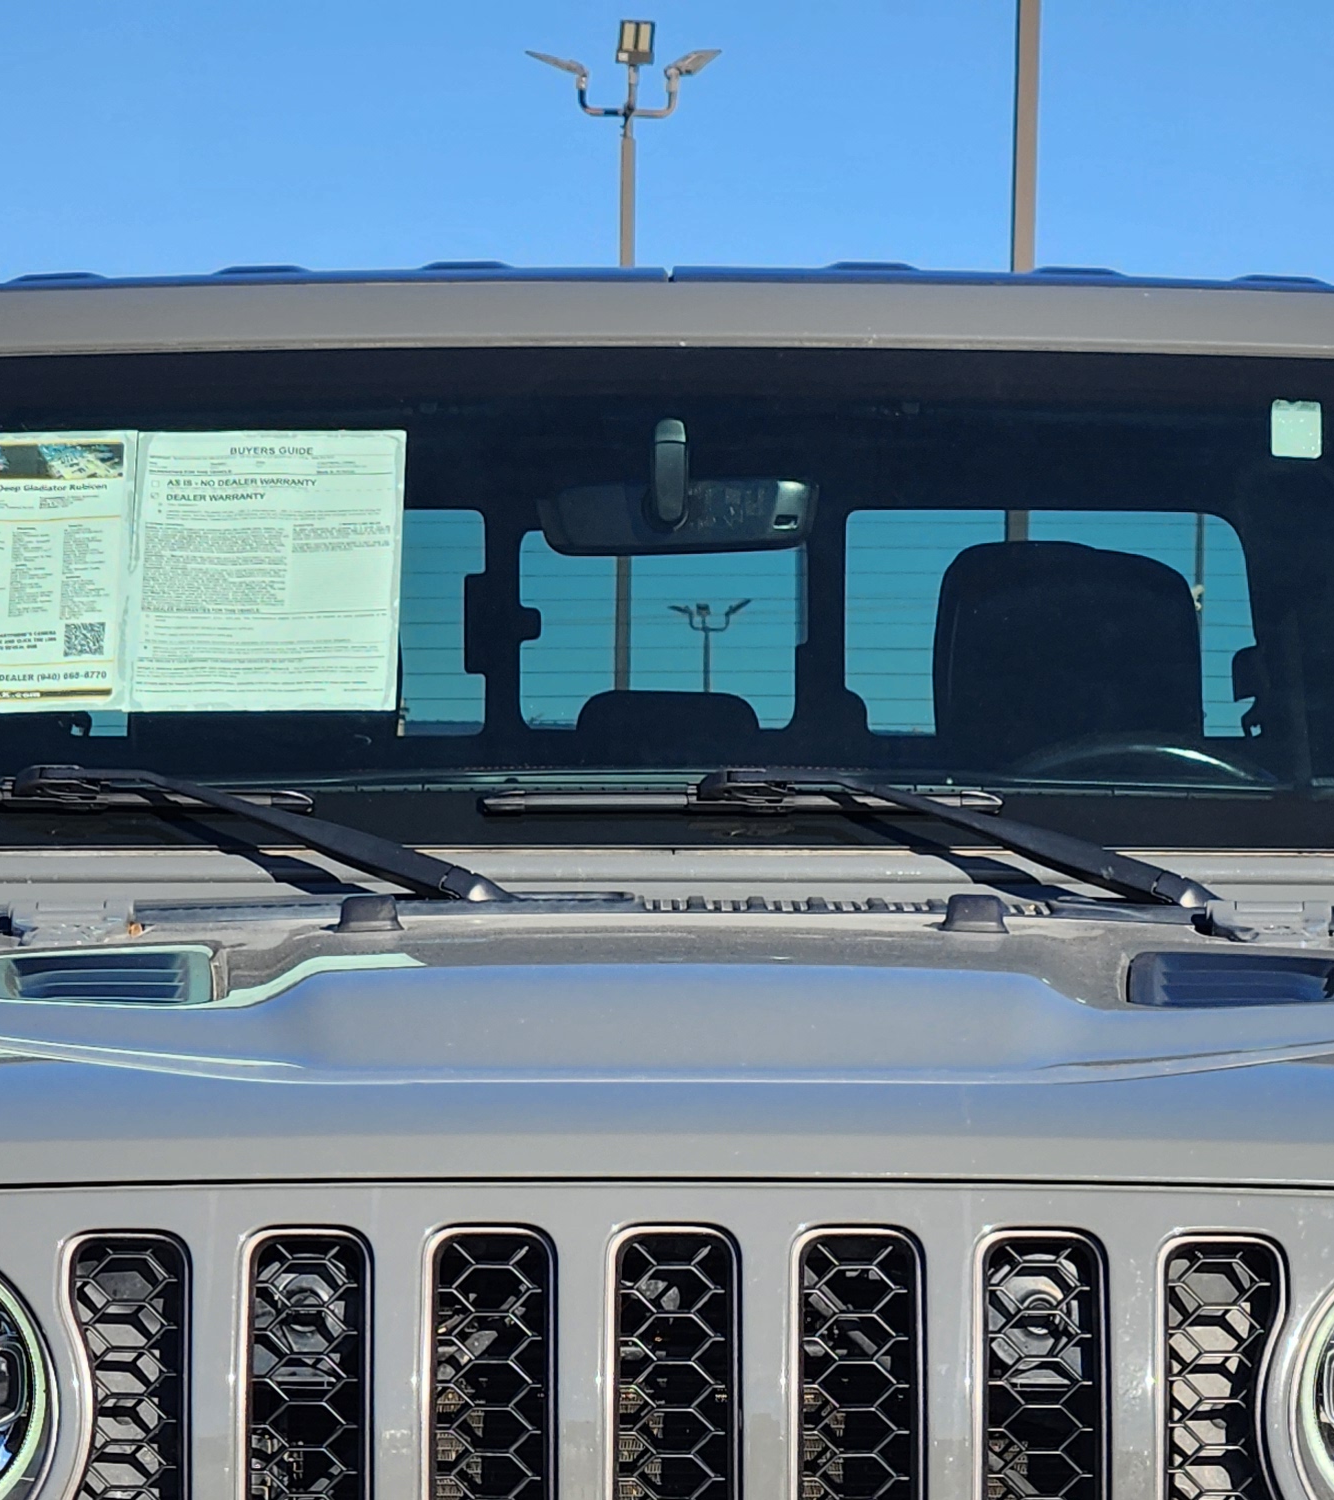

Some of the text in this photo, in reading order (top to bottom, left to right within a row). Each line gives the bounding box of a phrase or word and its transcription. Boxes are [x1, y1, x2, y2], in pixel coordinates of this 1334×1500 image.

[230, 446, 314, 455] BUYERS GUIDE
[167, 479, 181, 487] AS
[183, 479, 192, 487] IS
[200, 479, 215, 487] NO
[217, 478, 257, 487] DEALER
[260, 478, 317, 487] WARRANTY
[0, 484, 21, 493] Jeep
[23, 484, 67, 492] Gladiator
[69, 483, 108, 491] Rubicon
[166, 492, 265, 501] DEALER WARRANTY
[0, 673, 34, 682] DEALER
